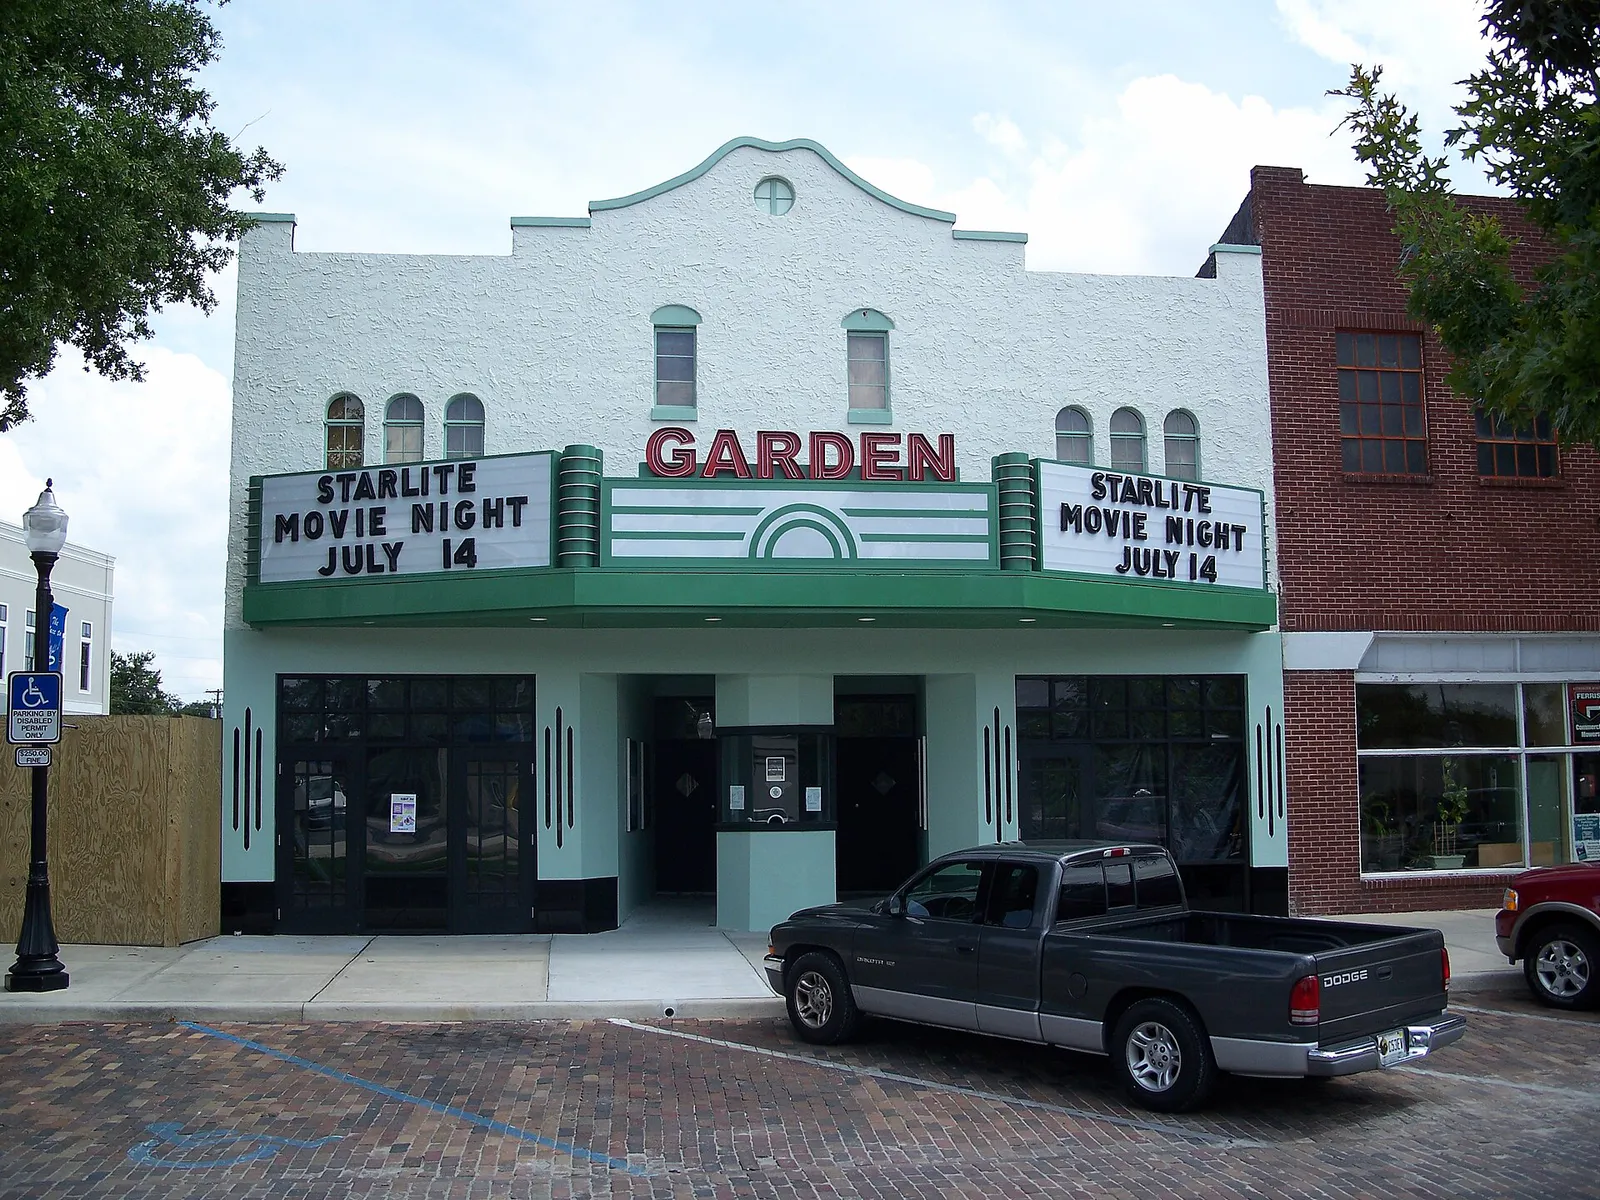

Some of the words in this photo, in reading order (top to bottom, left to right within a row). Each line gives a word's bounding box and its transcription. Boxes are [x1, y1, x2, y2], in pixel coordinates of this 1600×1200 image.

[645, 426, 956, 481] GARDEN
[317, 462, 477, 504] STARLITE
[1091, 472, 1212, 513] STARLITE
[274, 506, 387, 543] MOVIE
[411, 496, 528, 533] NIGHT
[1060, 502, 1147, 540] MOVIE
[1165, 516, 1247, 551] NIGHT
[317, 541, 404, 576] JULY
[442, 538, 477, 569] 14
[1115, 546, 1180, 578] JULY
[1189, 552, 1217, 583] 14
[1323, 969, 1368, 988] DODGE
